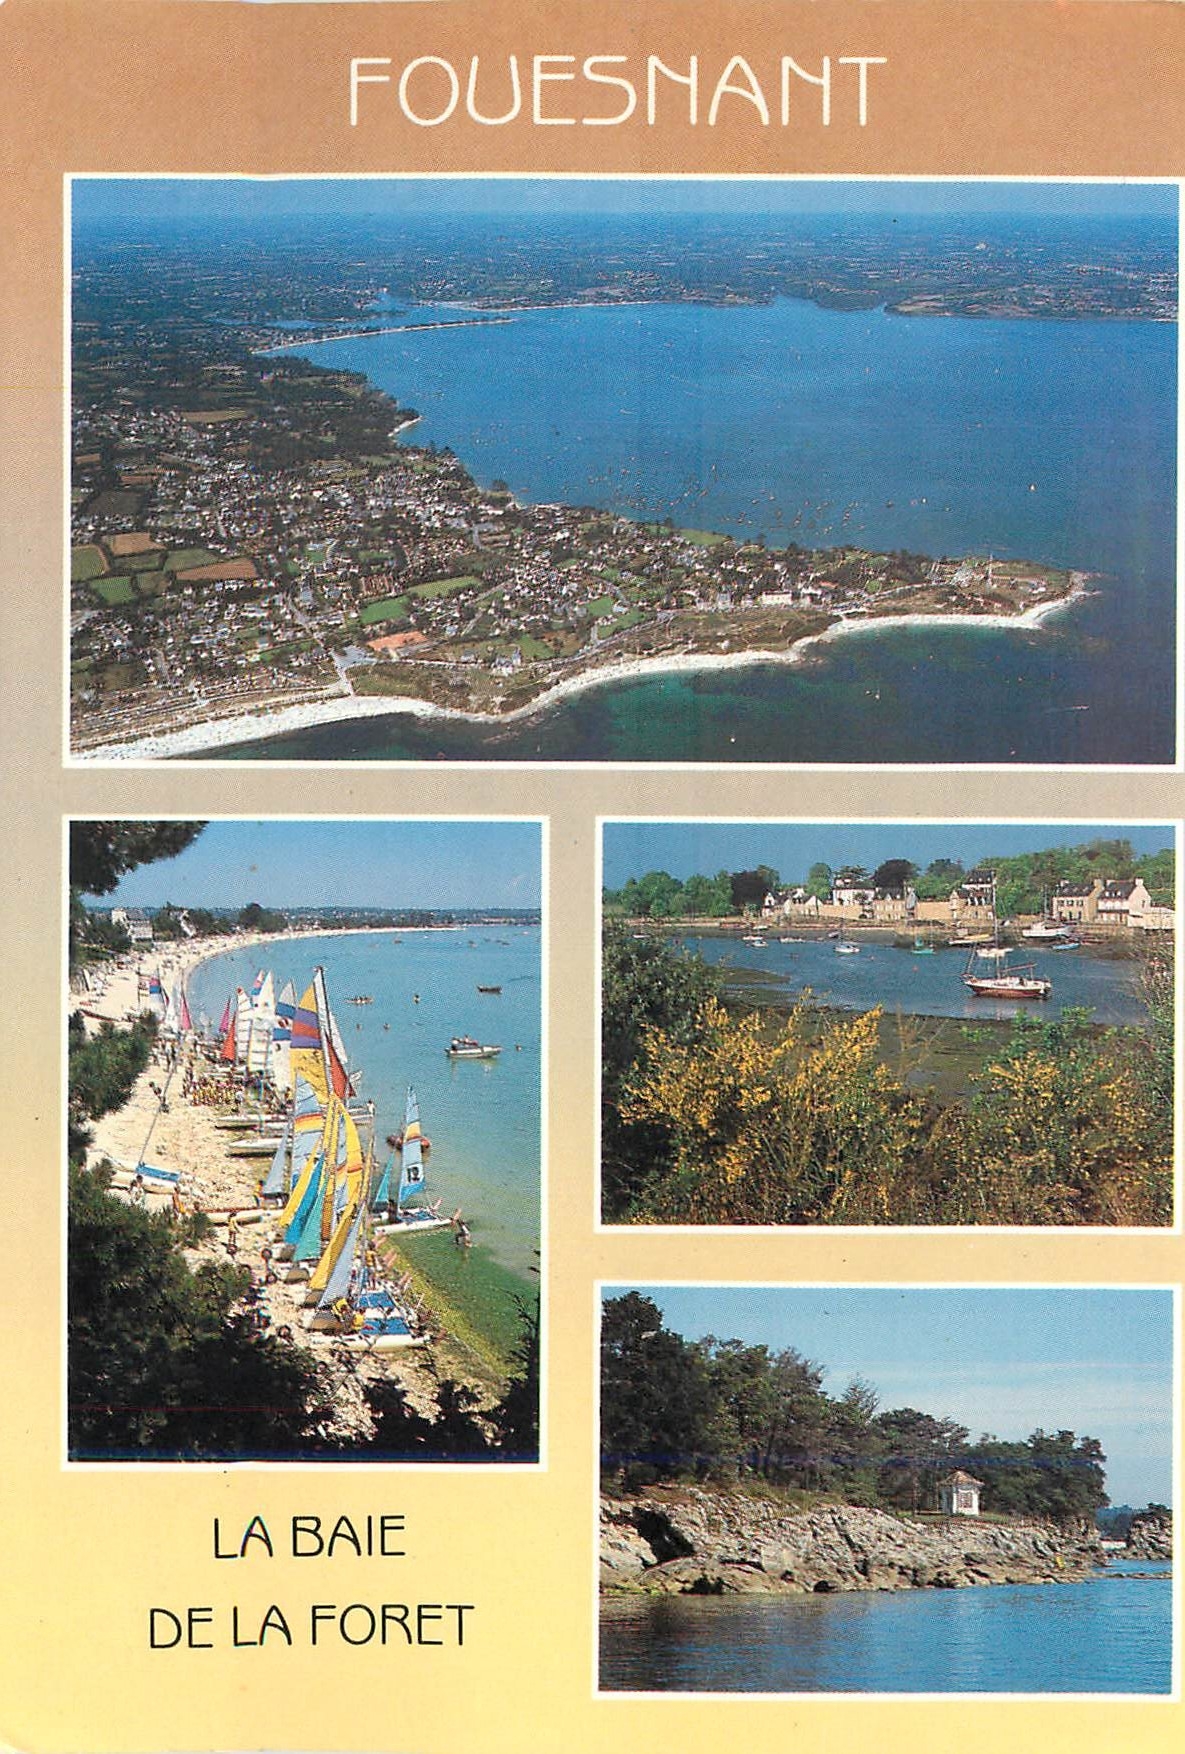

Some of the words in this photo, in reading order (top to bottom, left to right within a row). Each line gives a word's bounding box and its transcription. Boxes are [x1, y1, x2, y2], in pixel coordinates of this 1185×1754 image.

[351, 55, 888, 126] FOUESNANT
[214, 1516, 274, 1558] LA
[292, 1515, 406, 1558] BAIE
[150, 1607, 214, 1649] DE
[233, 1604, 293, 1647] LA
[312, 1603, 475, 1646] FORET
